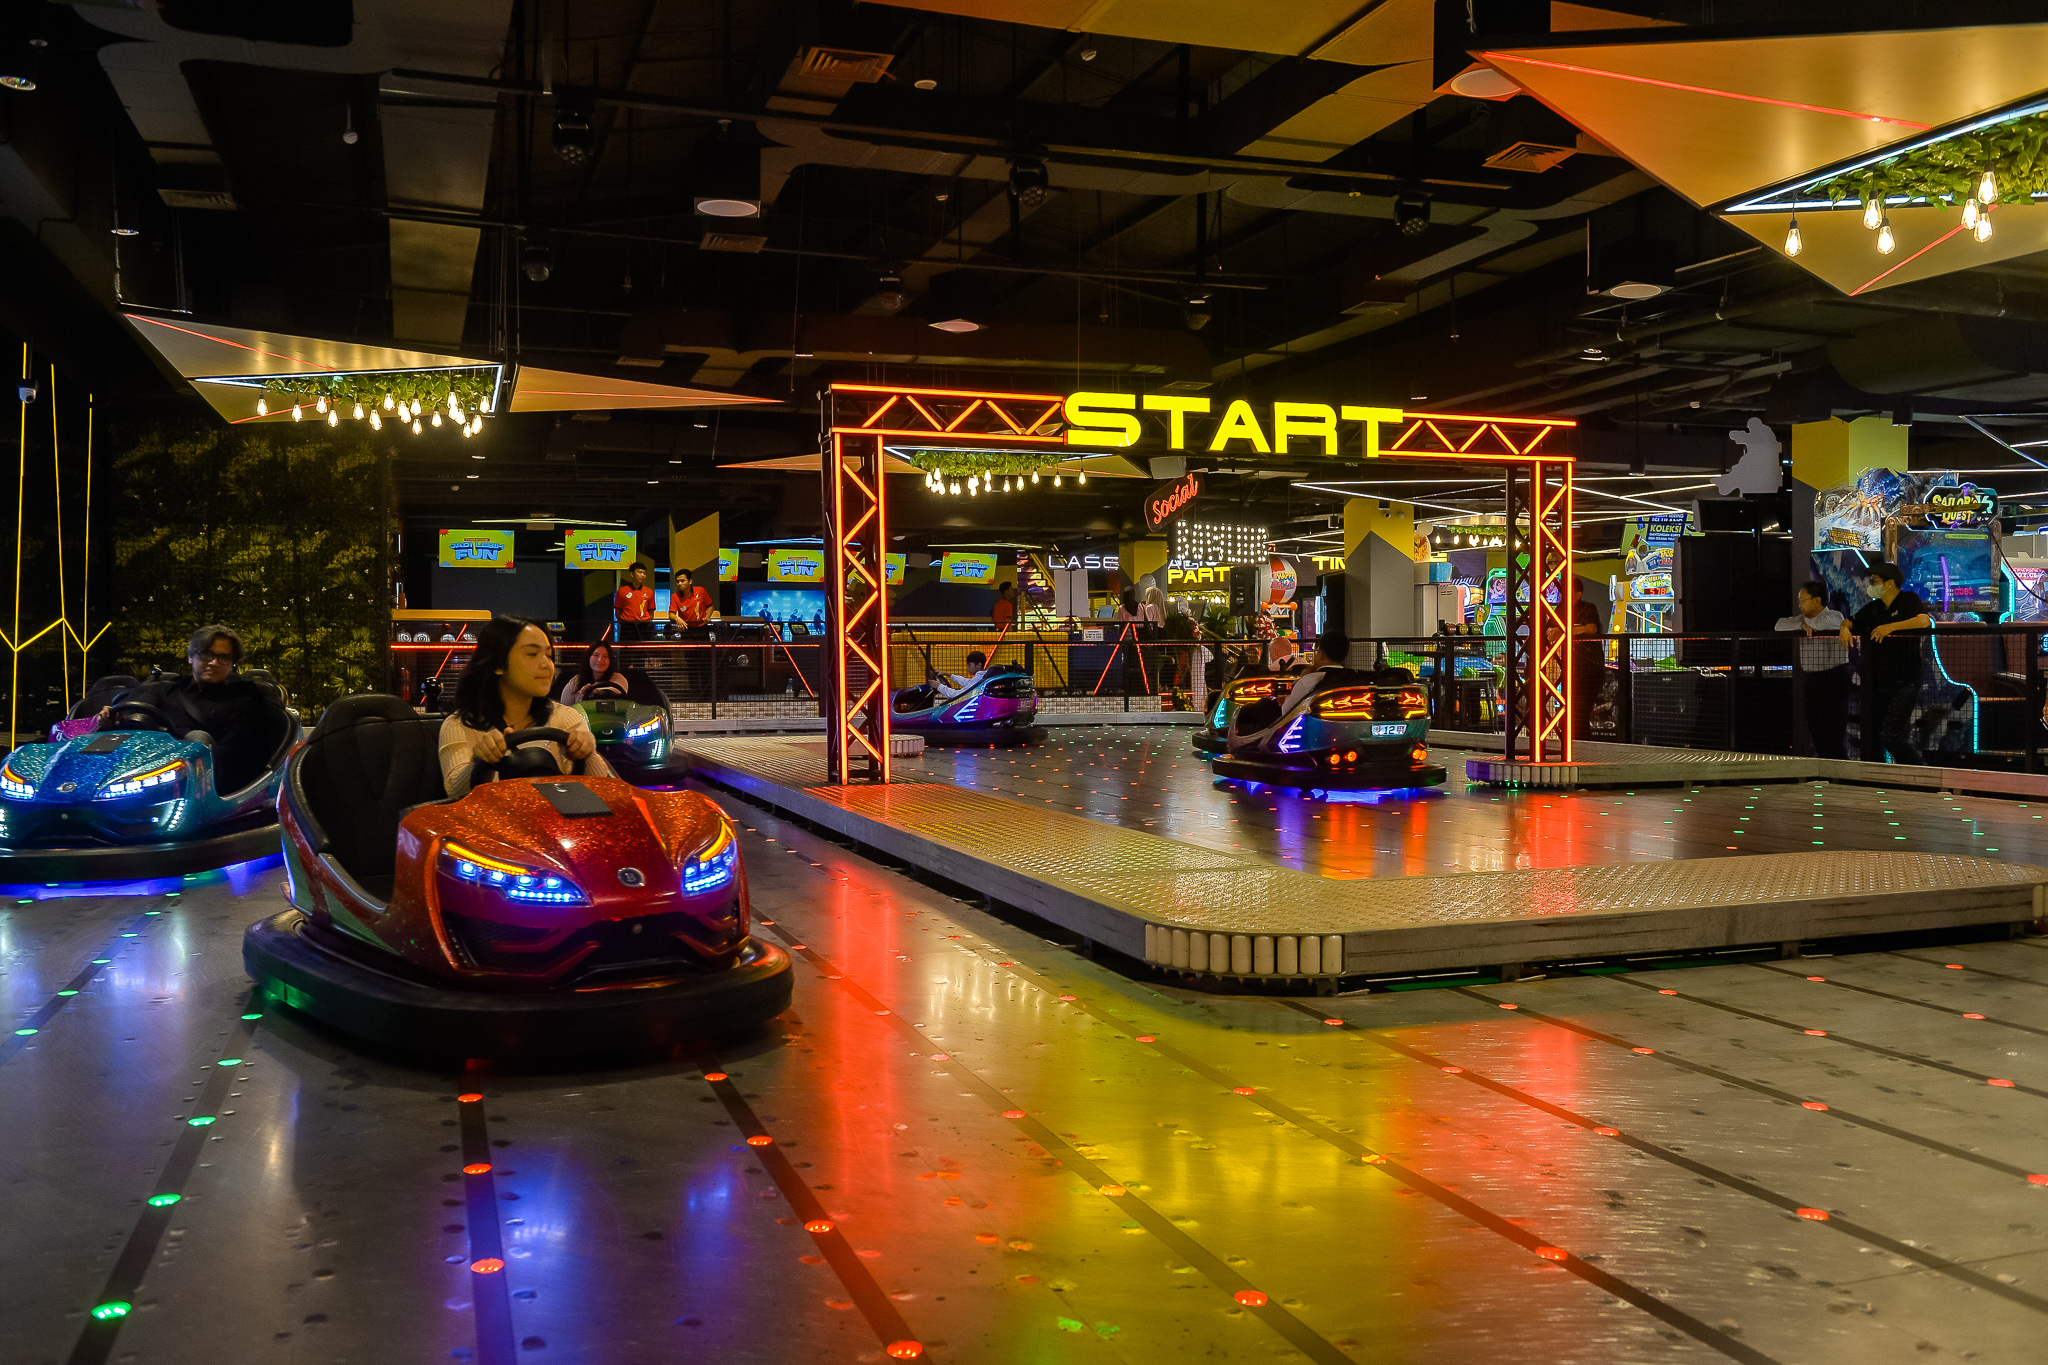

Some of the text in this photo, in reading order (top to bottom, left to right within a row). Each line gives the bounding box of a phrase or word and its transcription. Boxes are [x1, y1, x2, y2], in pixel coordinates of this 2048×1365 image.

[1065, 392, 1404, 458] START
[1152, 472, 1199, 525] Social
[1650, 525, 1682, 533] KOLEKSI
[455, 548, 499, 560] FUN
[580, 550, 622, 562] FUN
[780, 566, 814, 576] FUN
[952, 568, 985, 578] FUN
[1168, 566, 1233, 585] PART
[1384, 726, 1395, 735] 12
